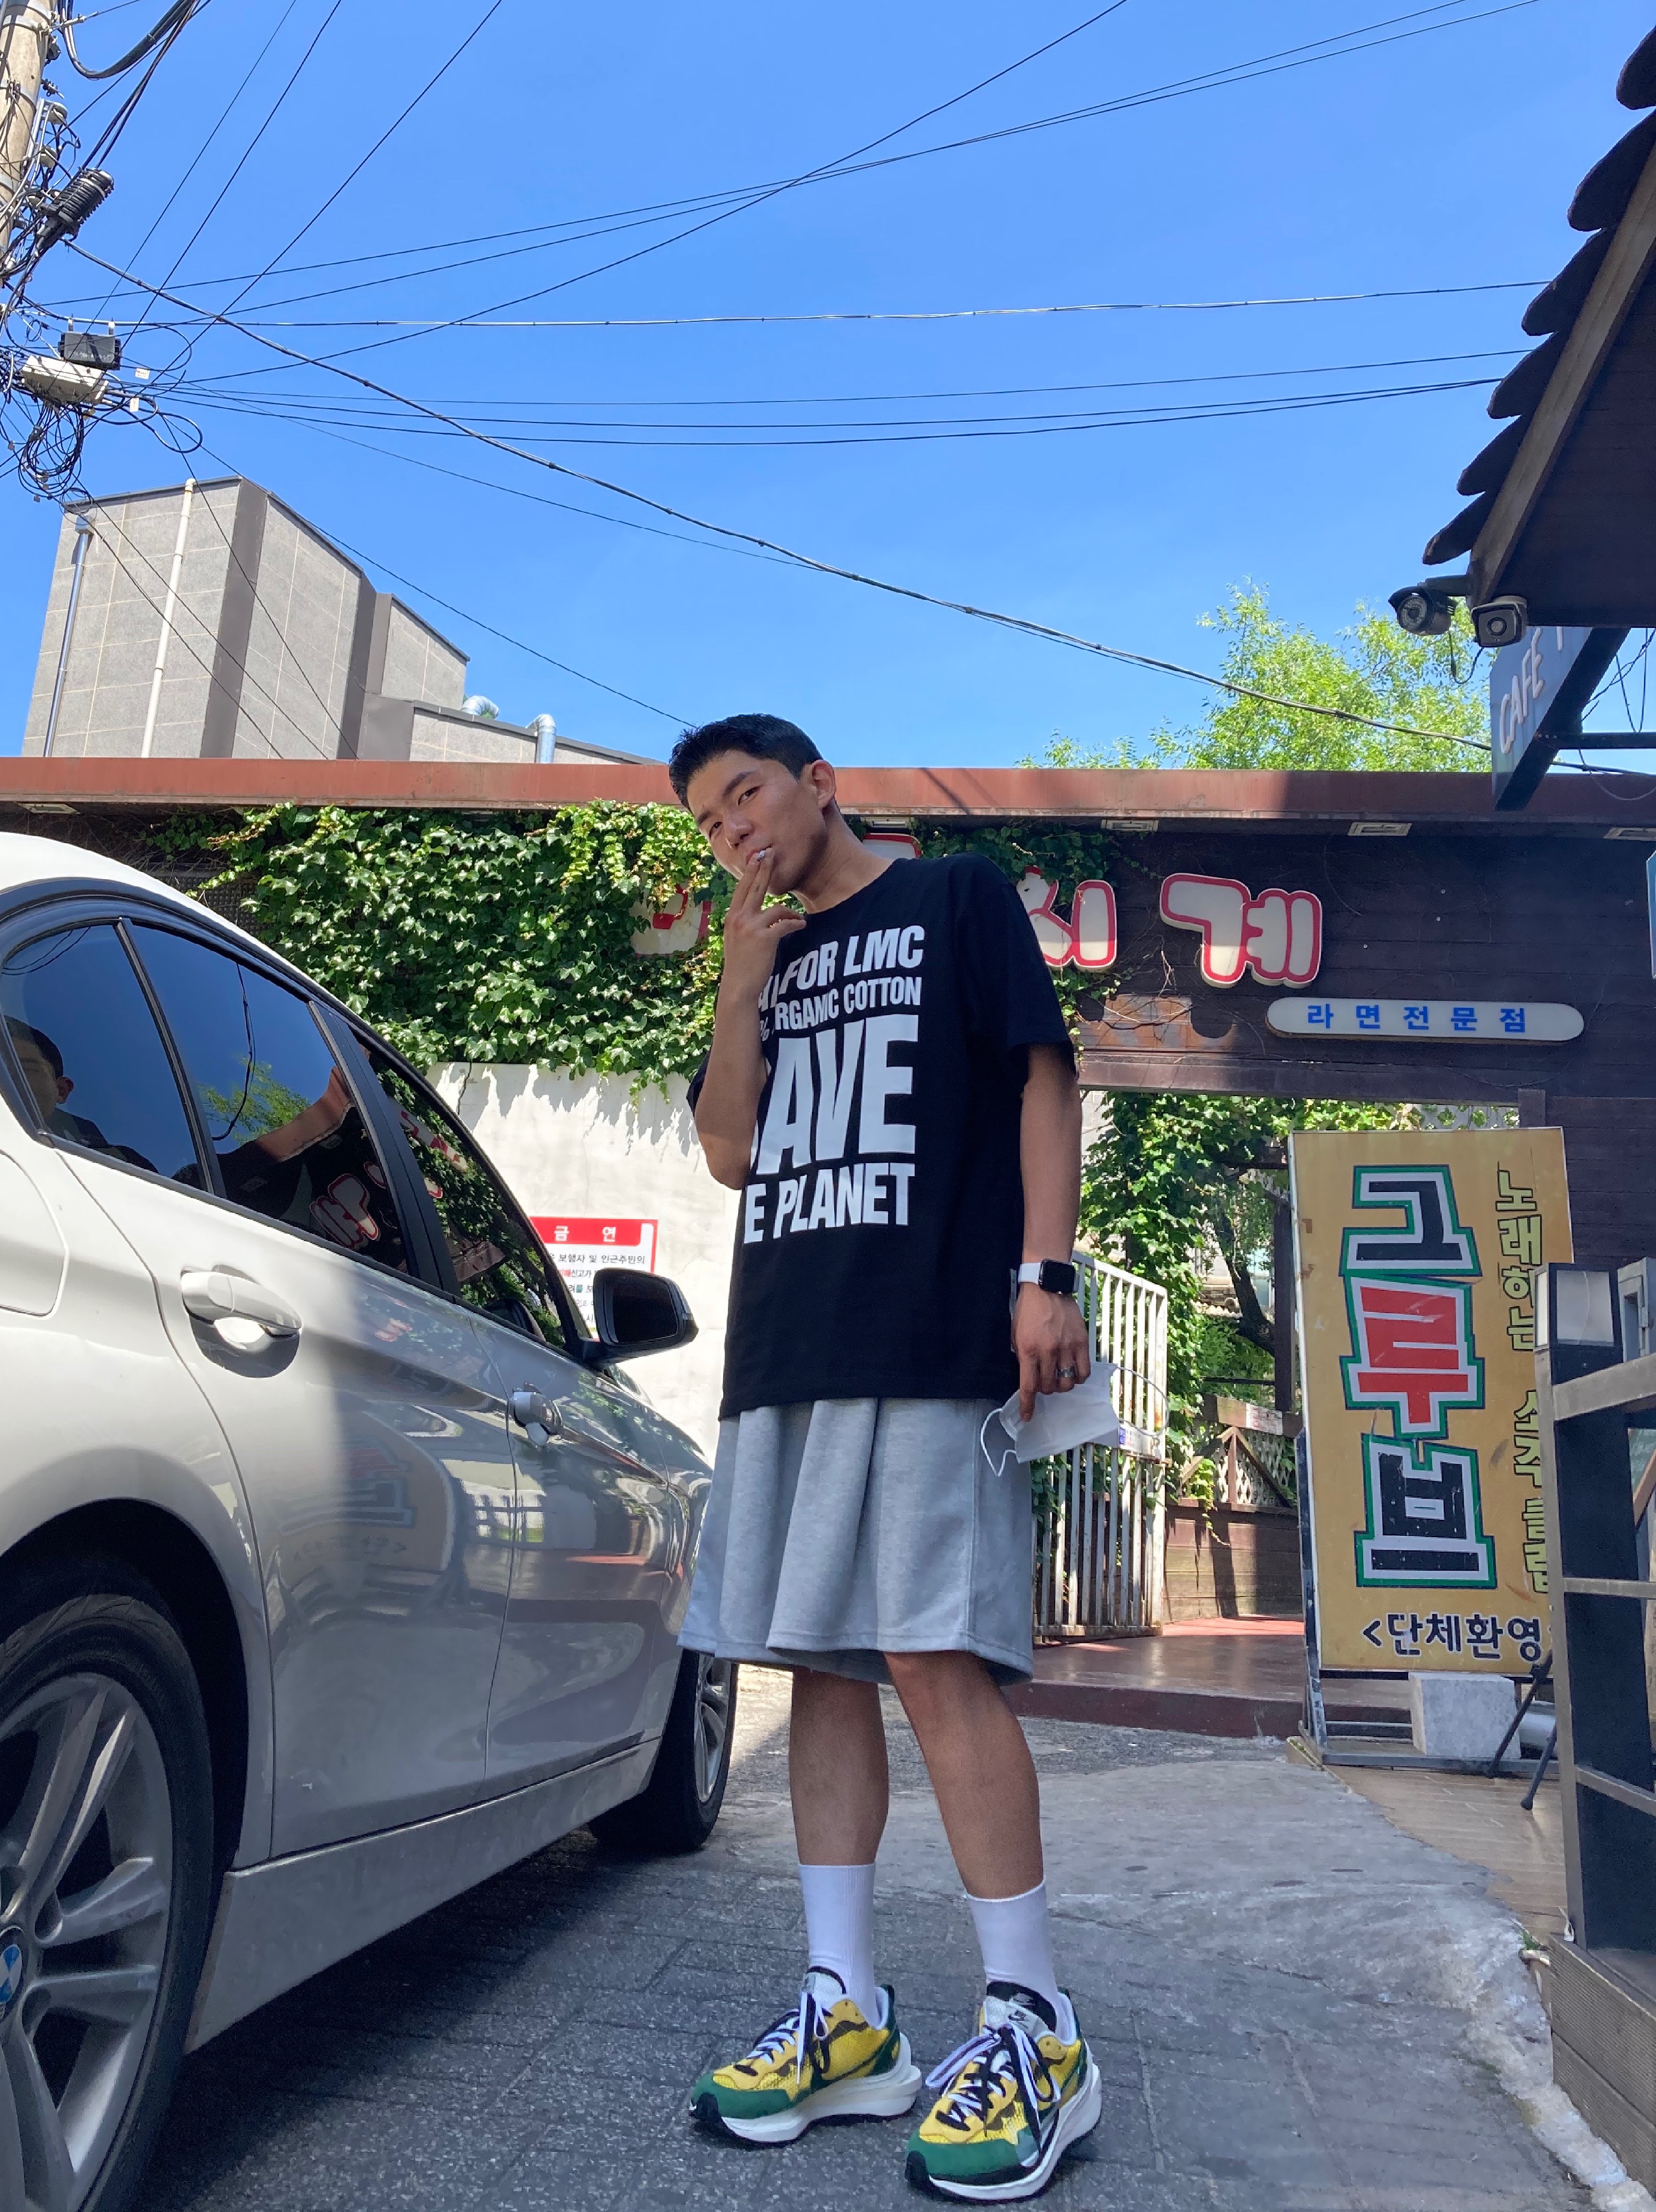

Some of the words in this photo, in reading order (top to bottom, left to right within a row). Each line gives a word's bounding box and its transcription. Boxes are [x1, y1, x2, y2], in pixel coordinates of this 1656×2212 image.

[1500, 627, 1545, 754] CAFE
[778, 940, 839, 995] FOR
[843, 925, 925, 976] LMC
[844, 976, 922, 1013] COTTON
[1307, 1003, 1525, 1033] 라면전문점
[750, 1013, 919, 1175] AVE
[773, 1162, 915, 1239] PLANET
